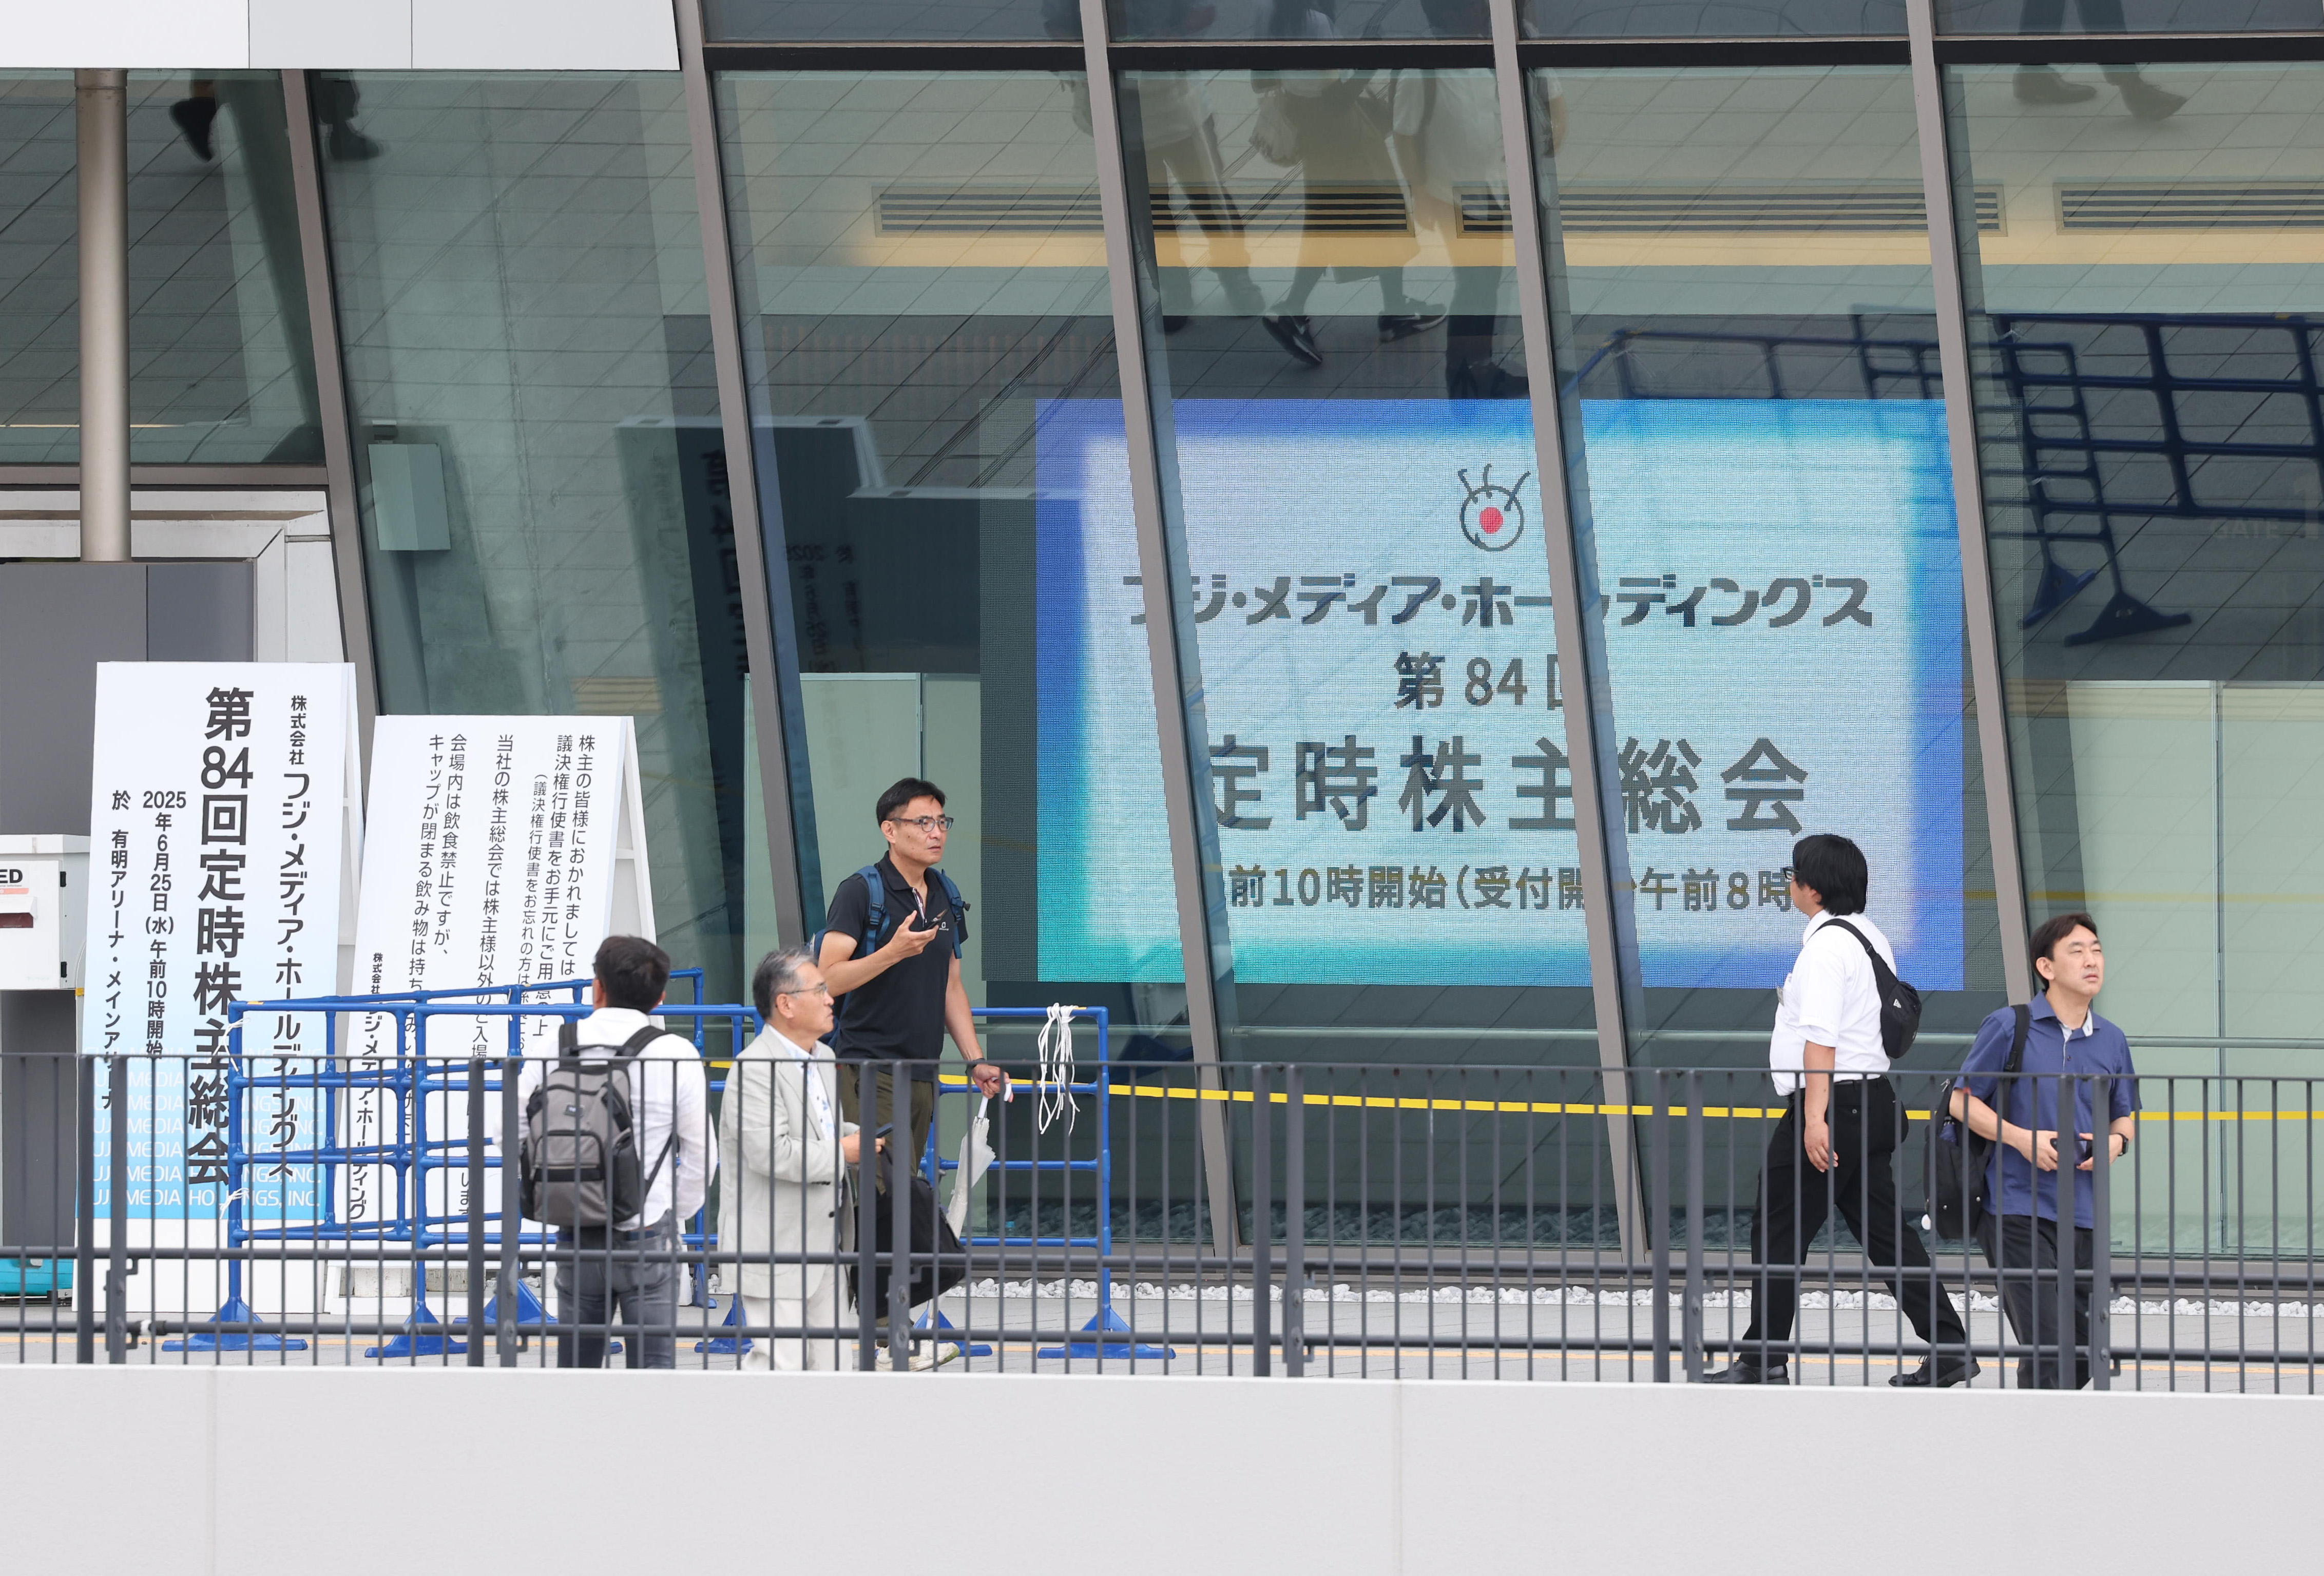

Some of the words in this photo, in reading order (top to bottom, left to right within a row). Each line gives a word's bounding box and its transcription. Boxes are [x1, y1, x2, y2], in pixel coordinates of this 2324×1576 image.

[1123, 573, 1872, 627] ジ・メディア・ホーディングス
[1210, 734, 1809, 835] 定時株主総会
[112, 790, 131, 810] 於
[434, 734, 467, 954] 会場内は飲食禁止ですが、
[561, 735, 595, 975] 株主の皆様におかれましては
[188, 687, 254, 1185] 第84回定時株主総会
[128, 1095, 184, 1110] MEDIA
[127, 1118, 183, 1134] MEDIA
[127, 1142, 183, 1158] MEDIA
[127, 1165, 182, 1182] MEDIA
[127, 1189, 181, 1205] MEDIA
